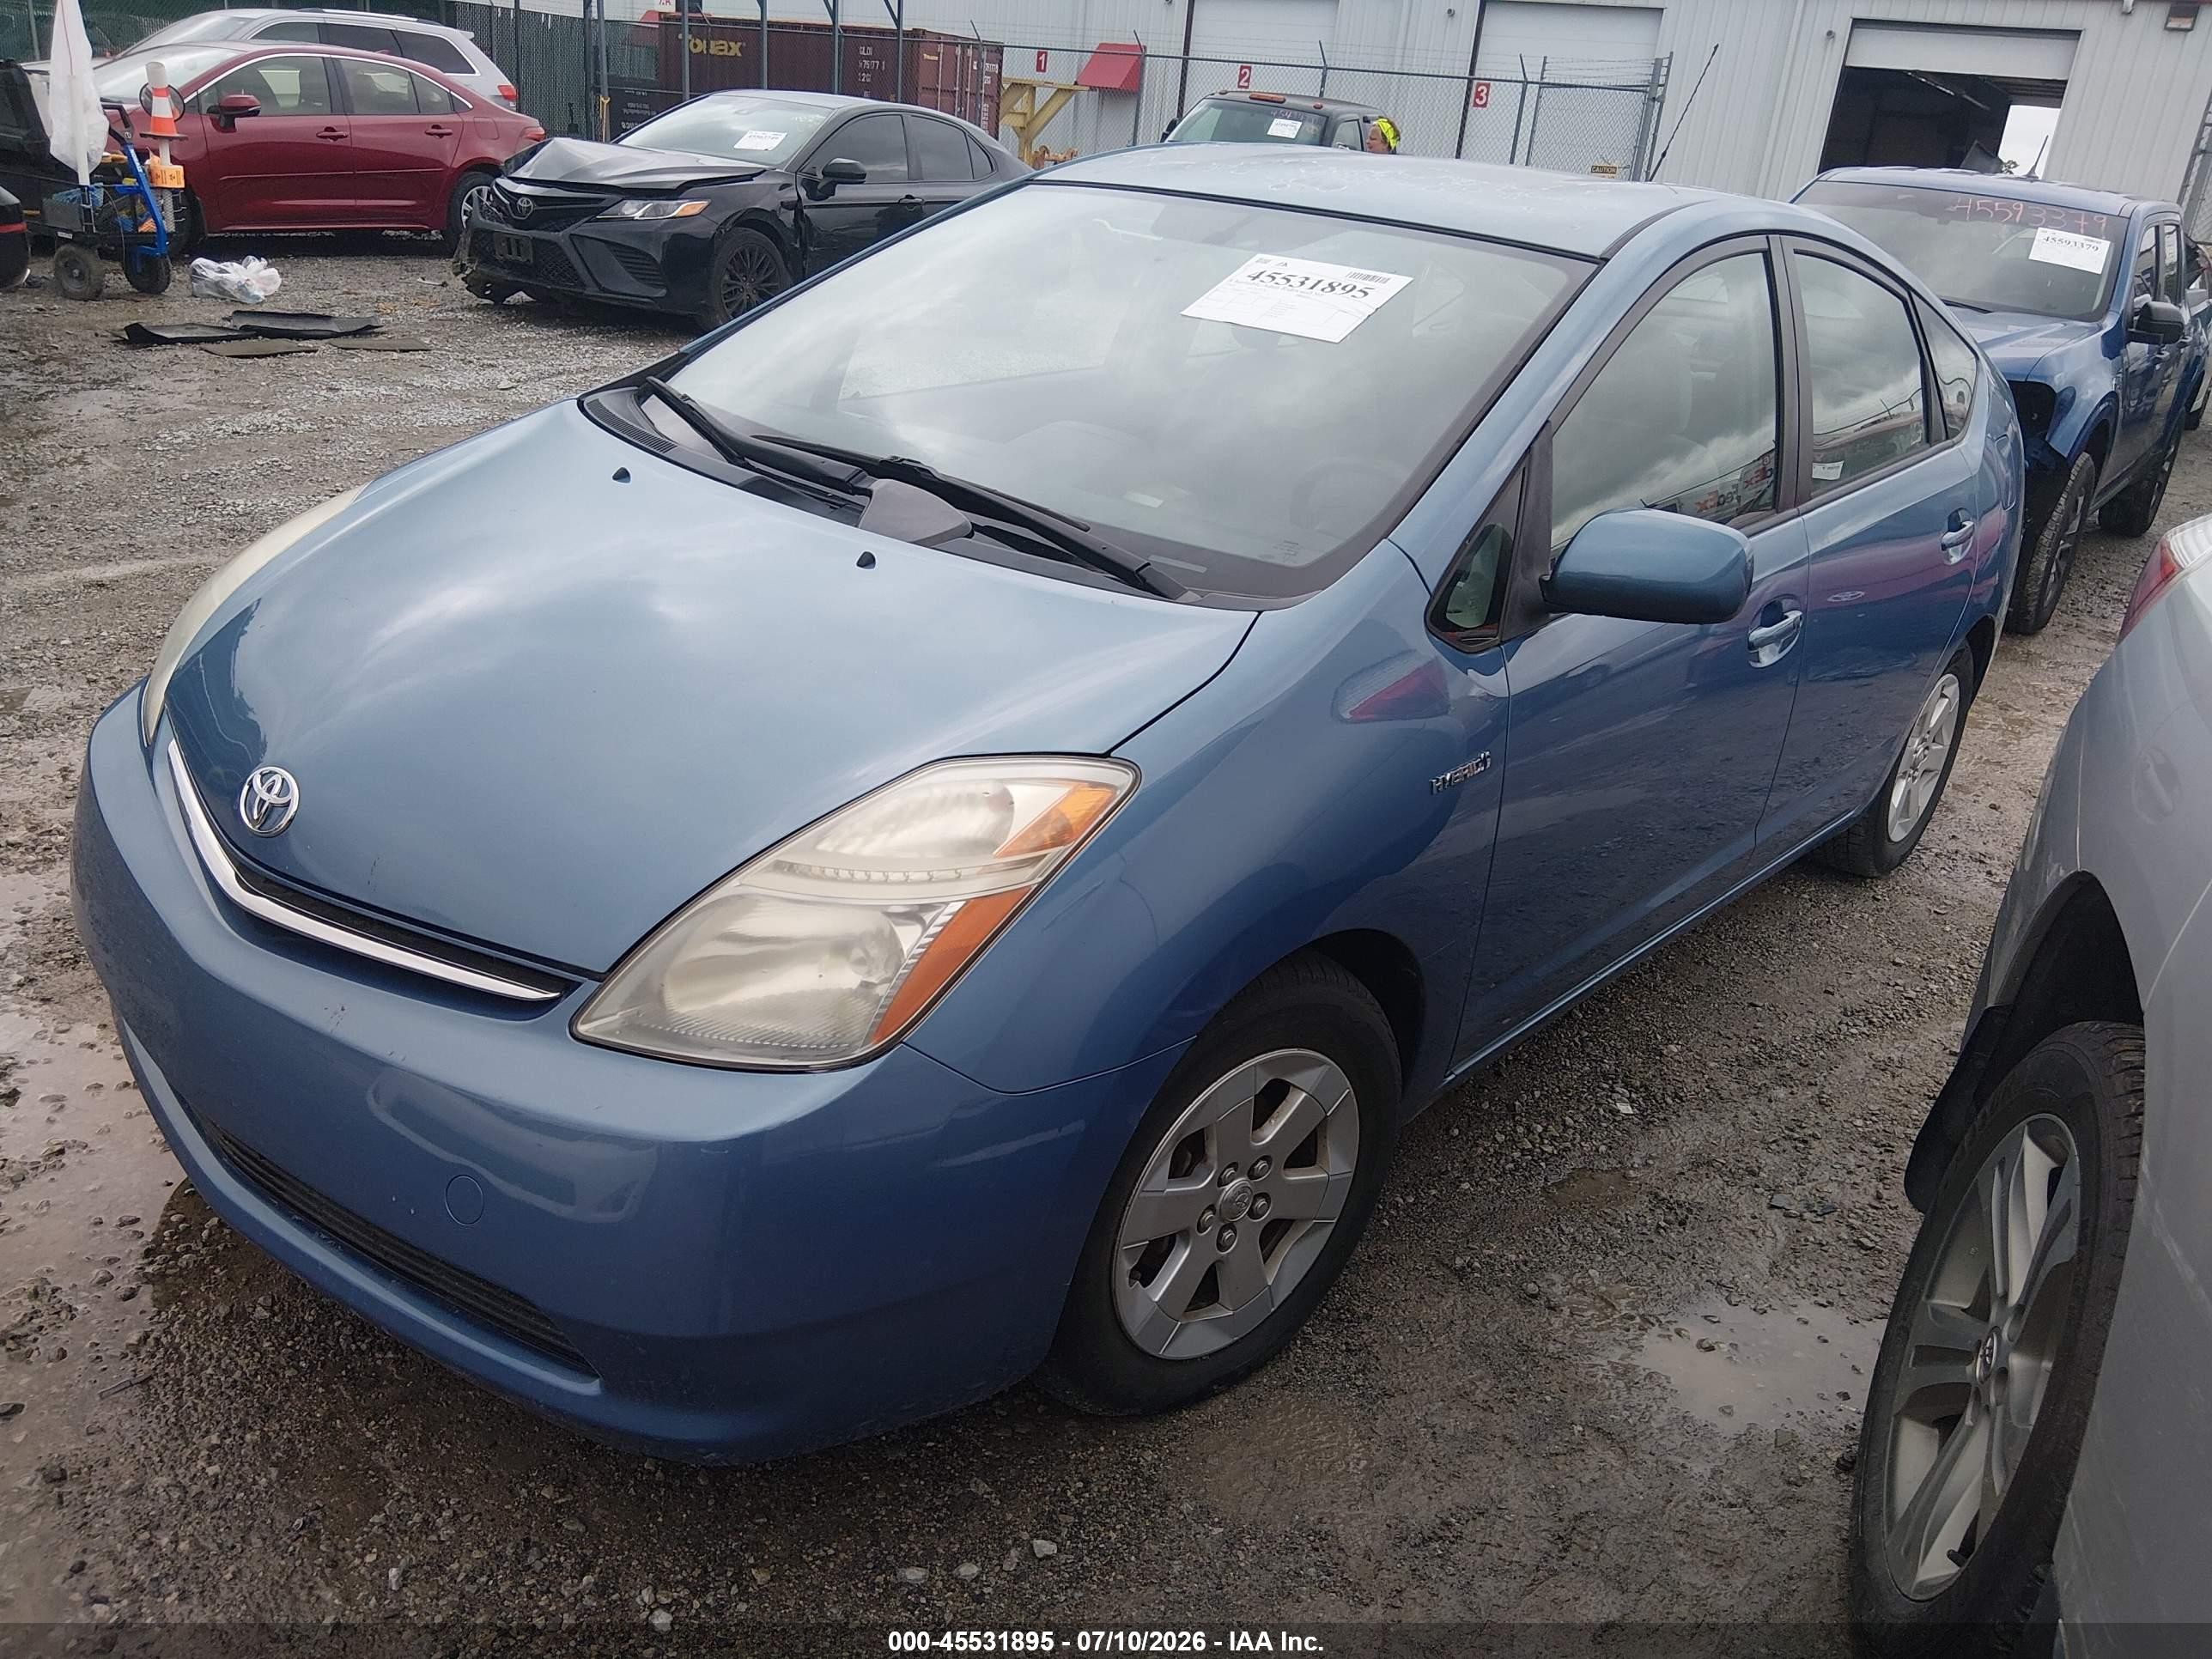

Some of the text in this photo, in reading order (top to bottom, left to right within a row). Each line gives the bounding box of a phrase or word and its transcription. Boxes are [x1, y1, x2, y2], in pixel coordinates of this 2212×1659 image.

[1239, 68, 1250, 87] 2
[1475, 85, 1487, 105] 3
[1953, 198, 2108, 240] 45593379
[1247, 270, 1376, 299] 45531895
